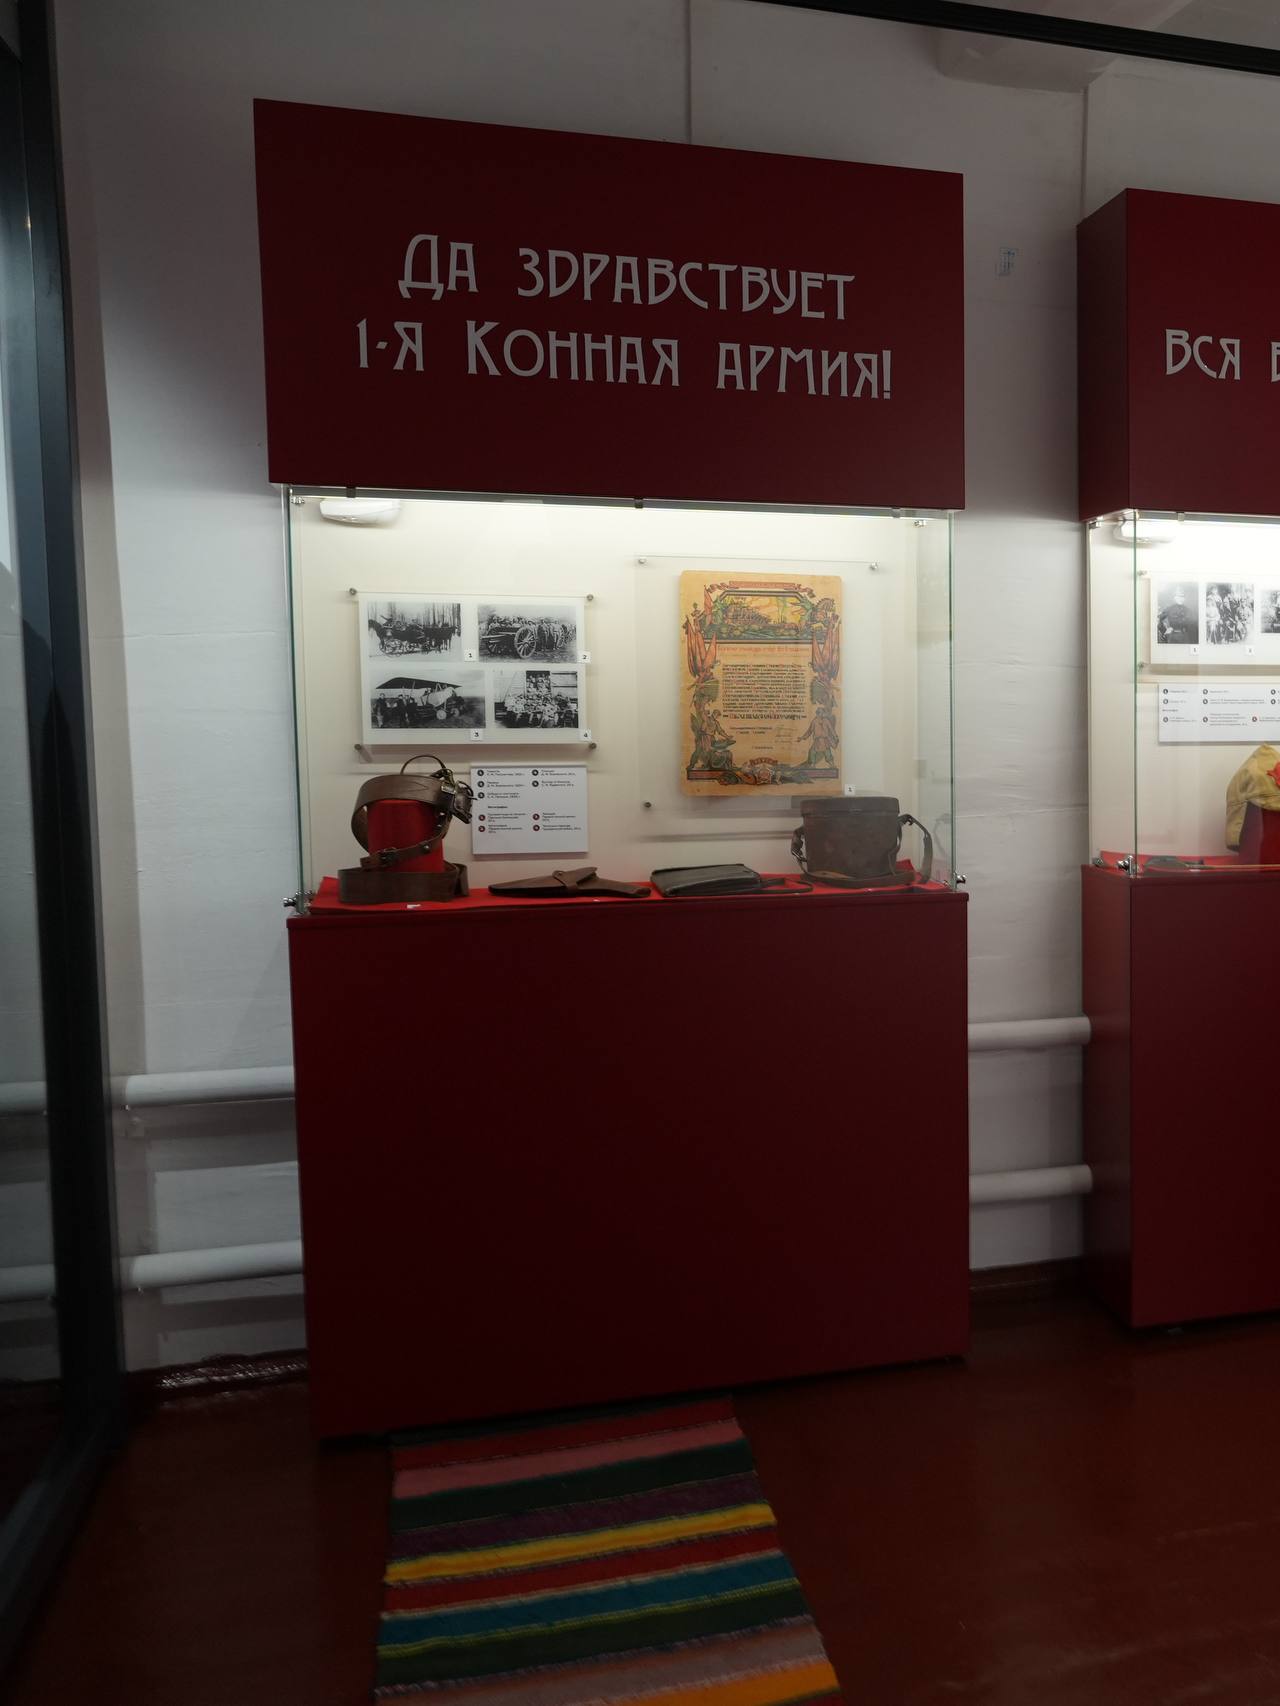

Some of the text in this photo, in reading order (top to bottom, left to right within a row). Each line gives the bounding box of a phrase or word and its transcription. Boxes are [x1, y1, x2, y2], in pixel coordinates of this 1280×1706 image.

[517, 247, 856, 320] ЗДРАВСТВУЕТ
[356, 318, 892, 400] 1-Я КОННАЯ АРМИЯ!
[1165, 328, 1241, 381] ВСЯ
